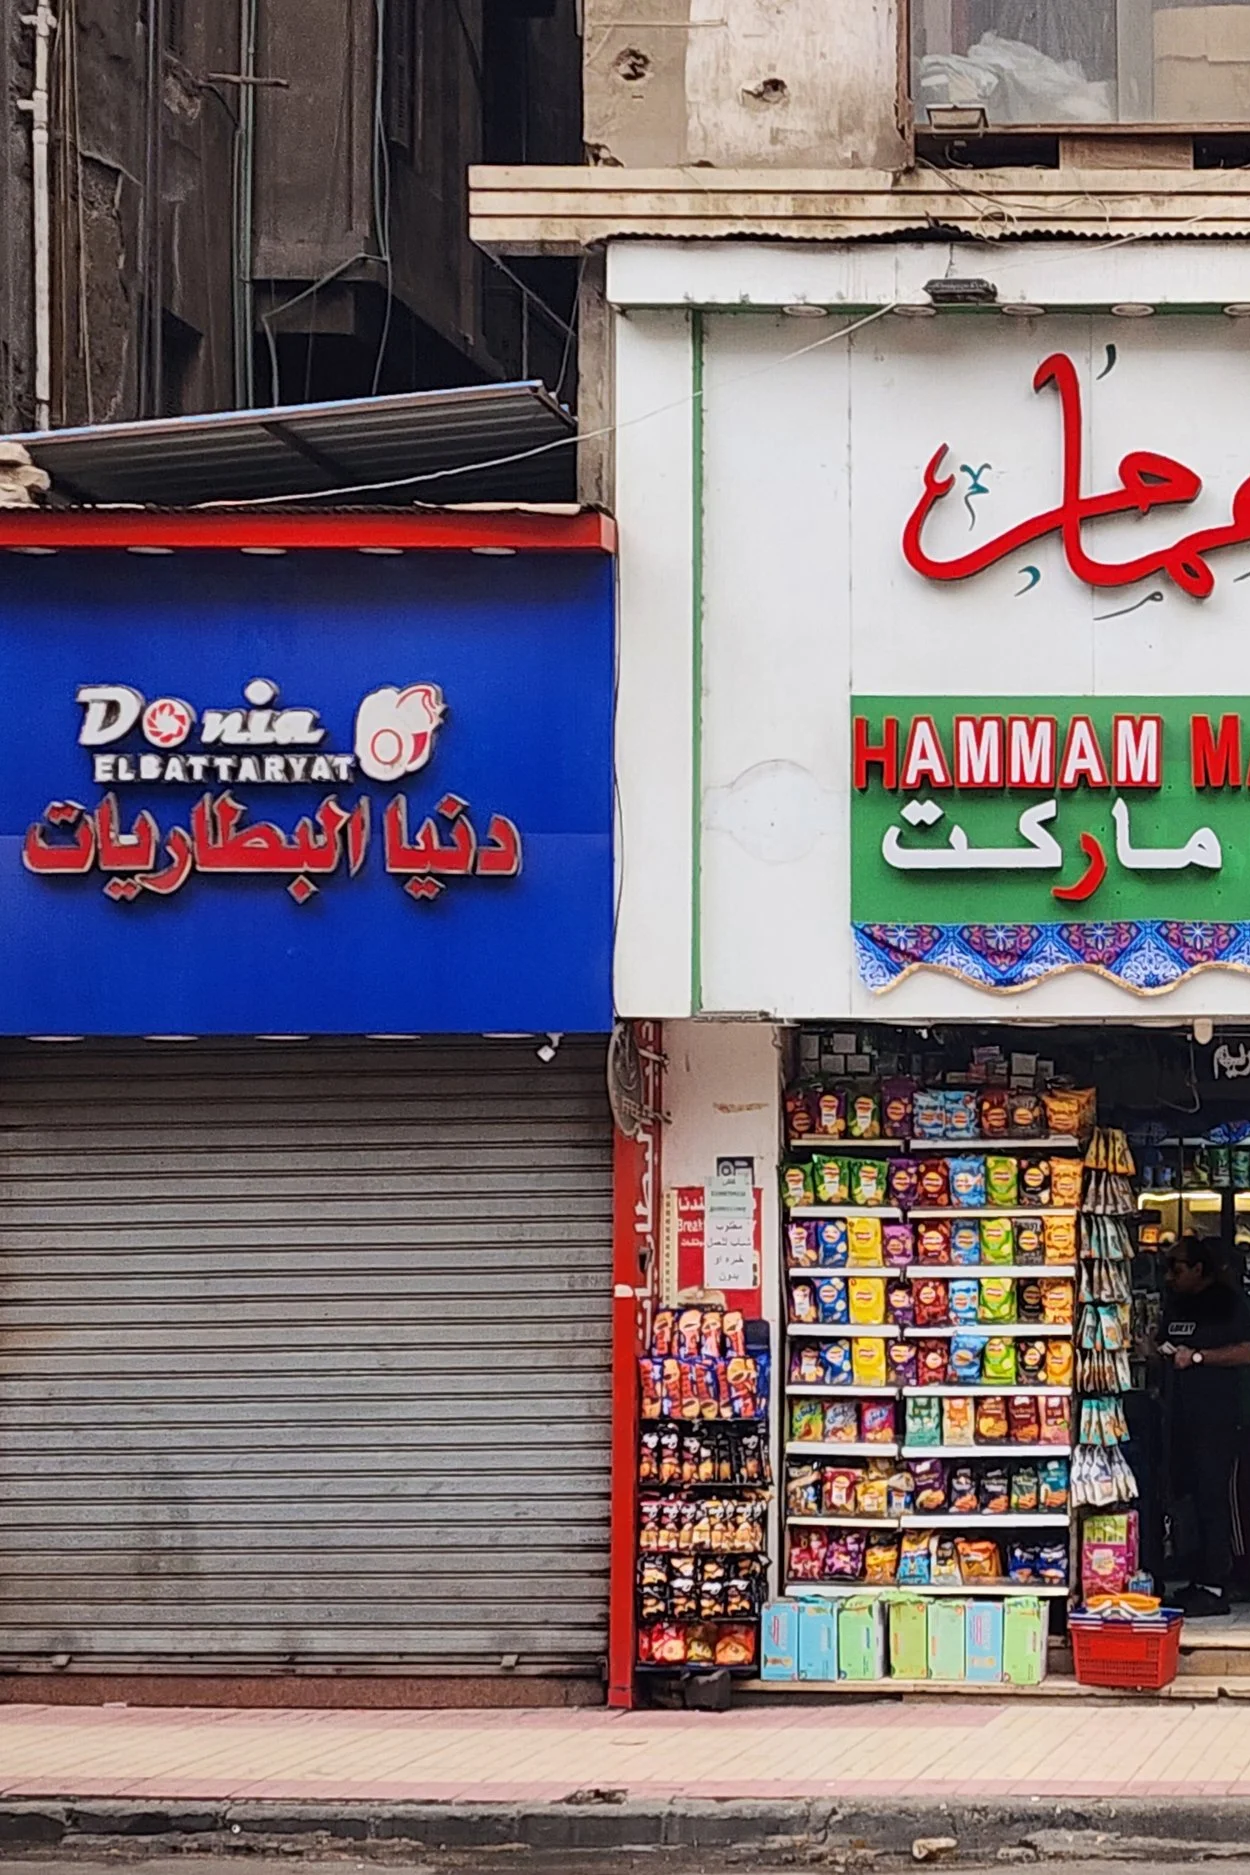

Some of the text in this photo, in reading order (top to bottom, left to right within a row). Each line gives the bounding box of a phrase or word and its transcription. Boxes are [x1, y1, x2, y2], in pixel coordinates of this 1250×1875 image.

[76, 678, 325, 750] Donia
[852, 713, 1163, 790] HAMMAM
[93, 754, 356, 783] ELBATTARYAT
[22, 790, 523, 904] دنيا البطاريات
[881, 797, 1223, 901] ماركت
